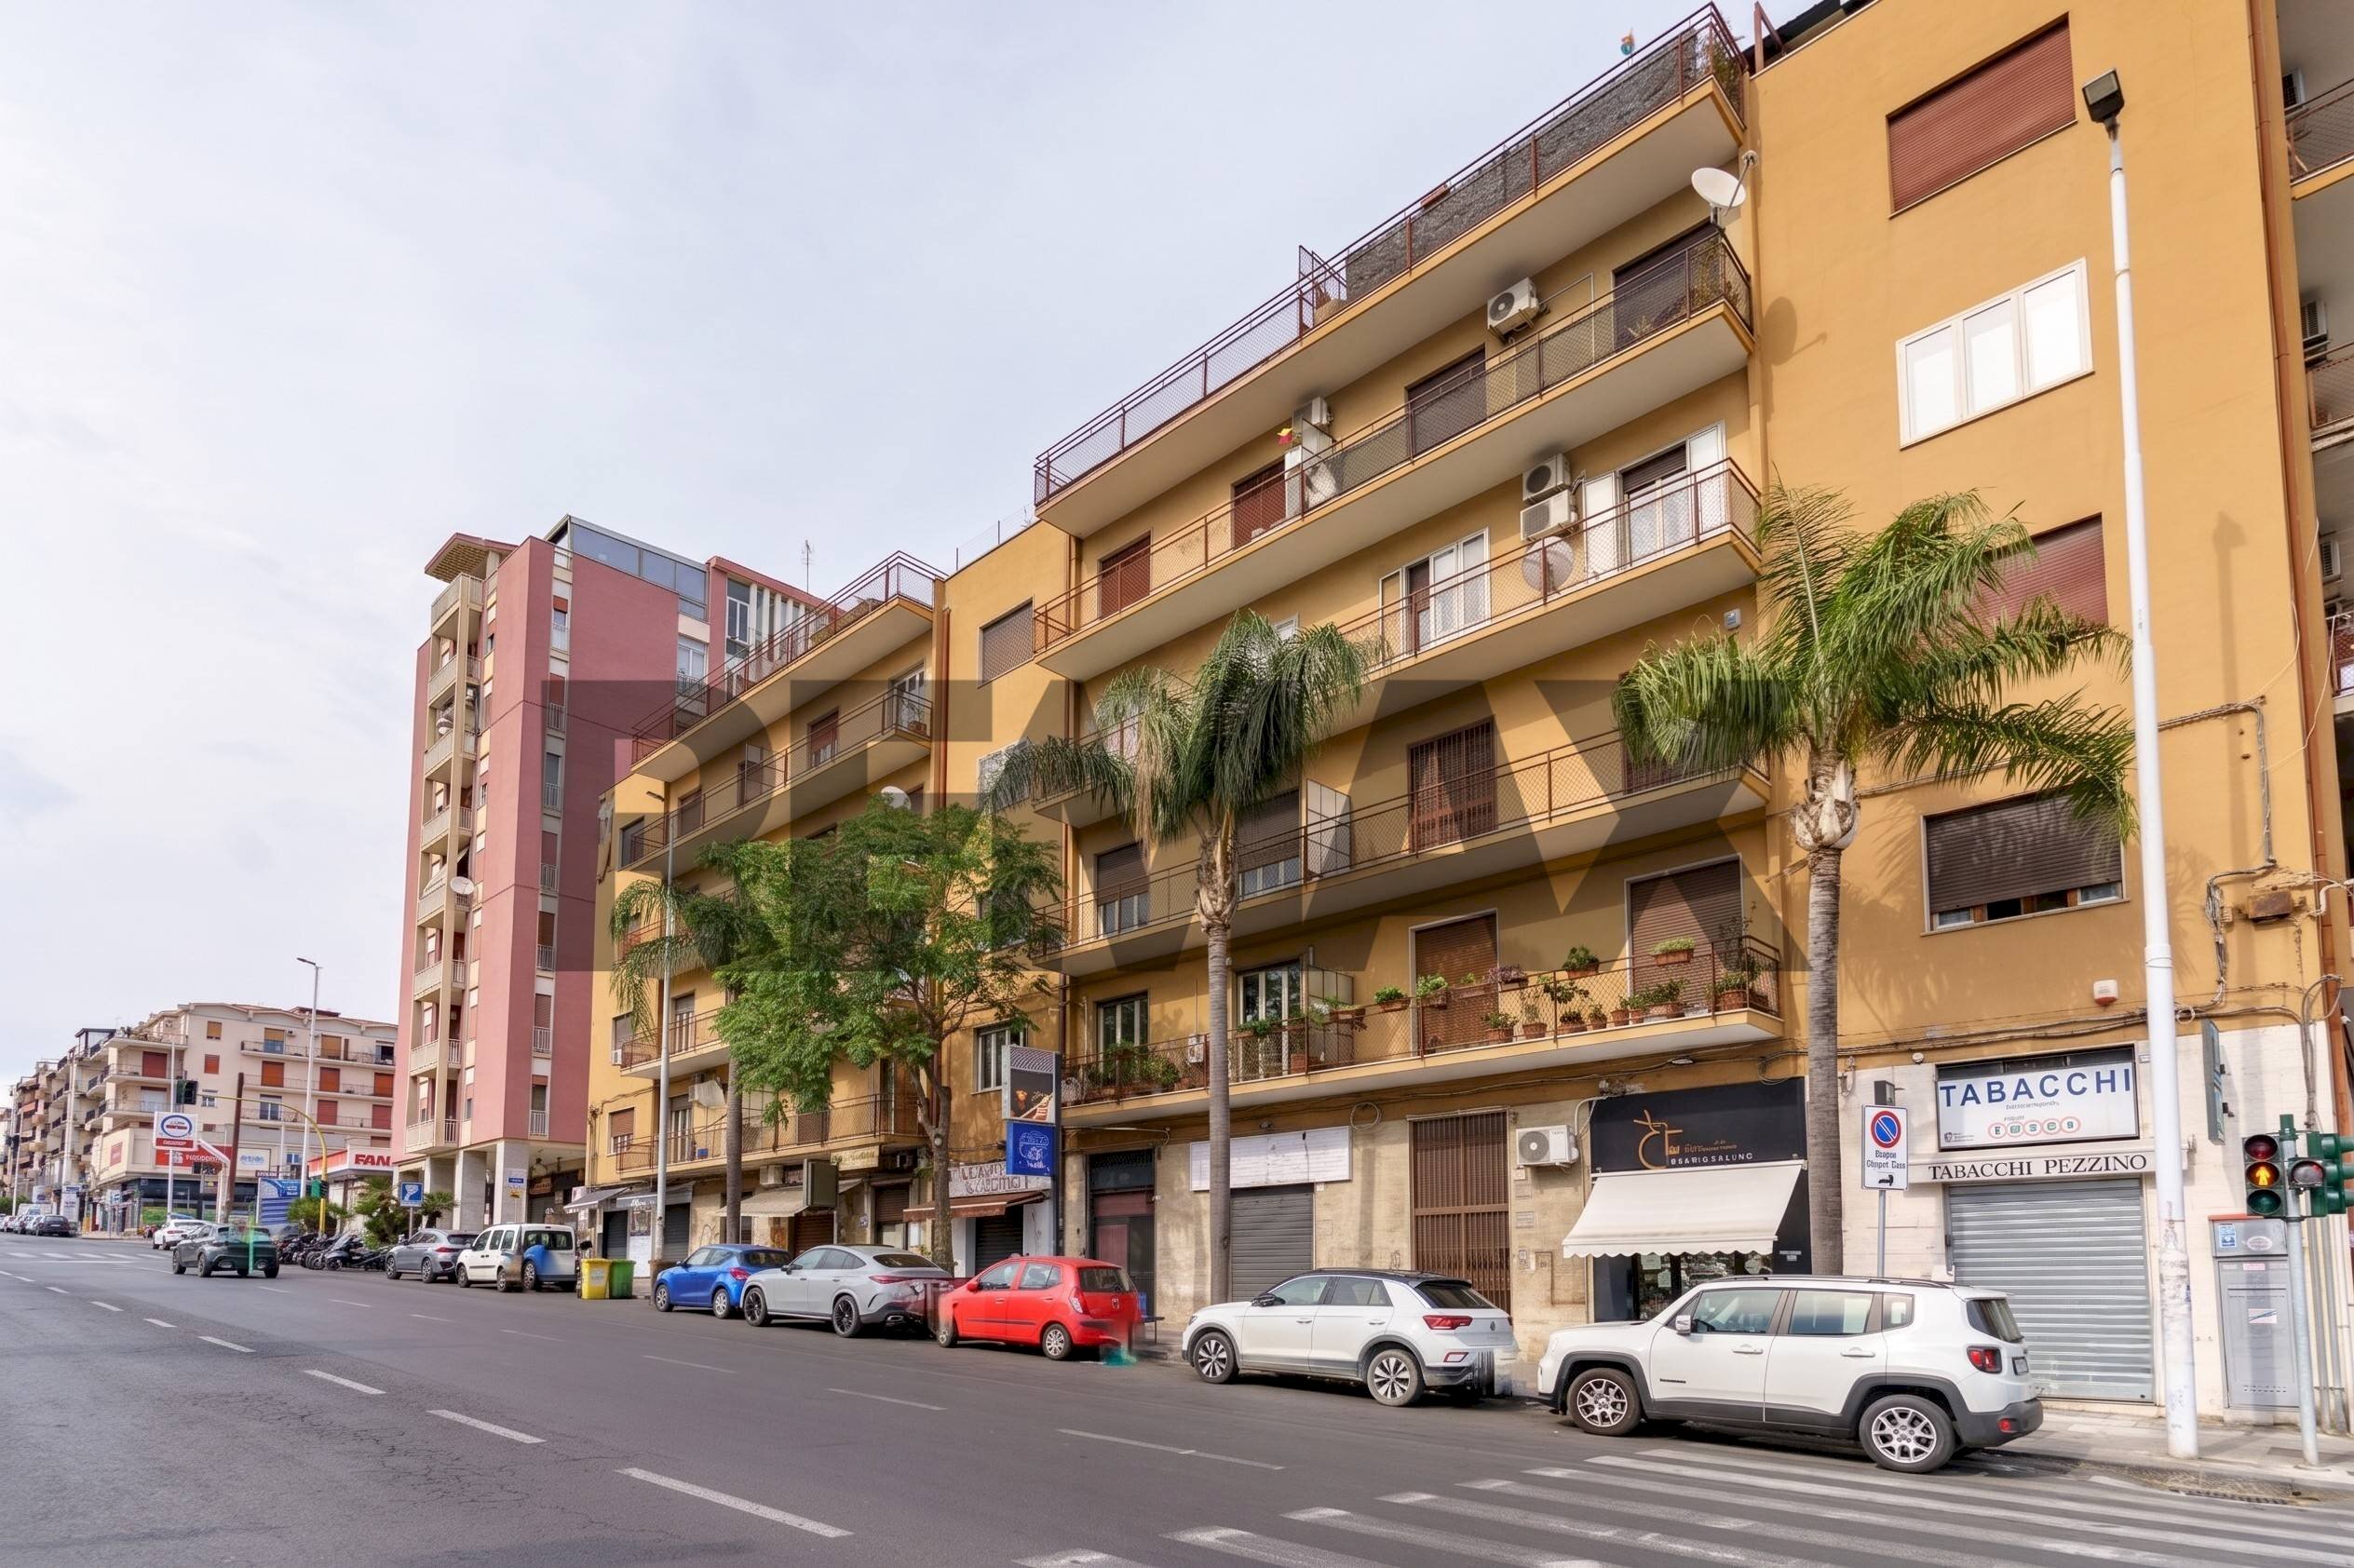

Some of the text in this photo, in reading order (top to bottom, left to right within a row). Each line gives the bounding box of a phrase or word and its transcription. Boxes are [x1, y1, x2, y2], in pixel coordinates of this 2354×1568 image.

[1940, 1068, 2131, 1107] TABACCHI
[1928, 1155, 2147, 1180] TABACCHI PEZZINO
